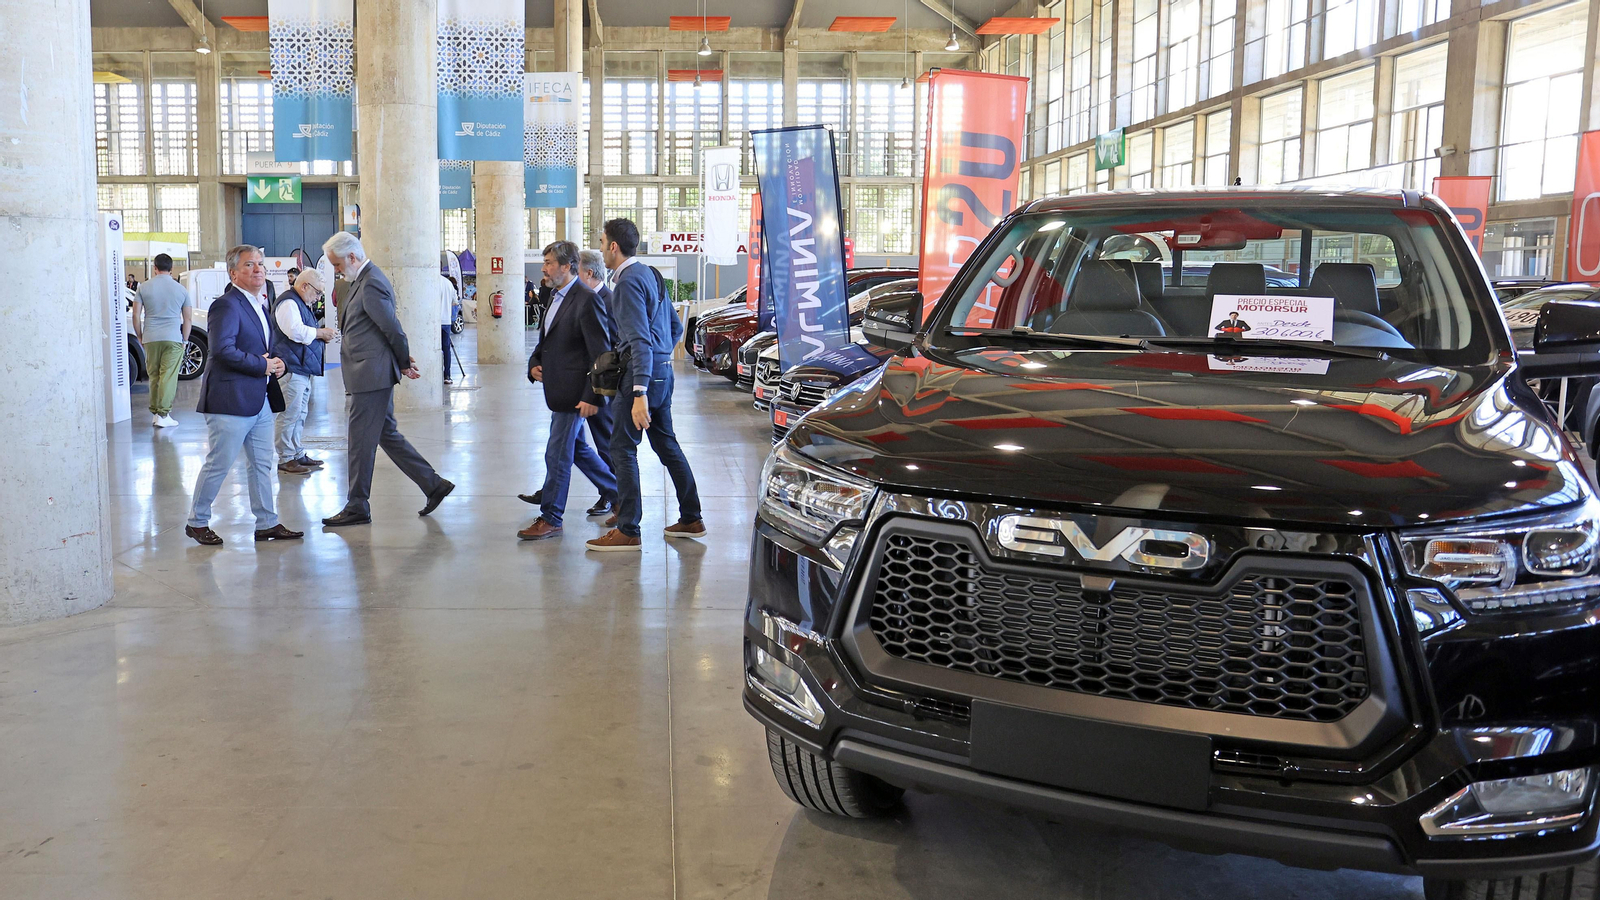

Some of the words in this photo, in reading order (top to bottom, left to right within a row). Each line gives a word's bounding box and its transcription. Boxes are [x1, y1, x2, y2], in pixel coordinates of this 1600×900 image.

[529, 82, 572, 94] IFECA
[1236, 304, 1308, 313] MOTORSUR
[1272, 320, 1312, 328] Desde
[998, 516, 1209, 570] EVO
